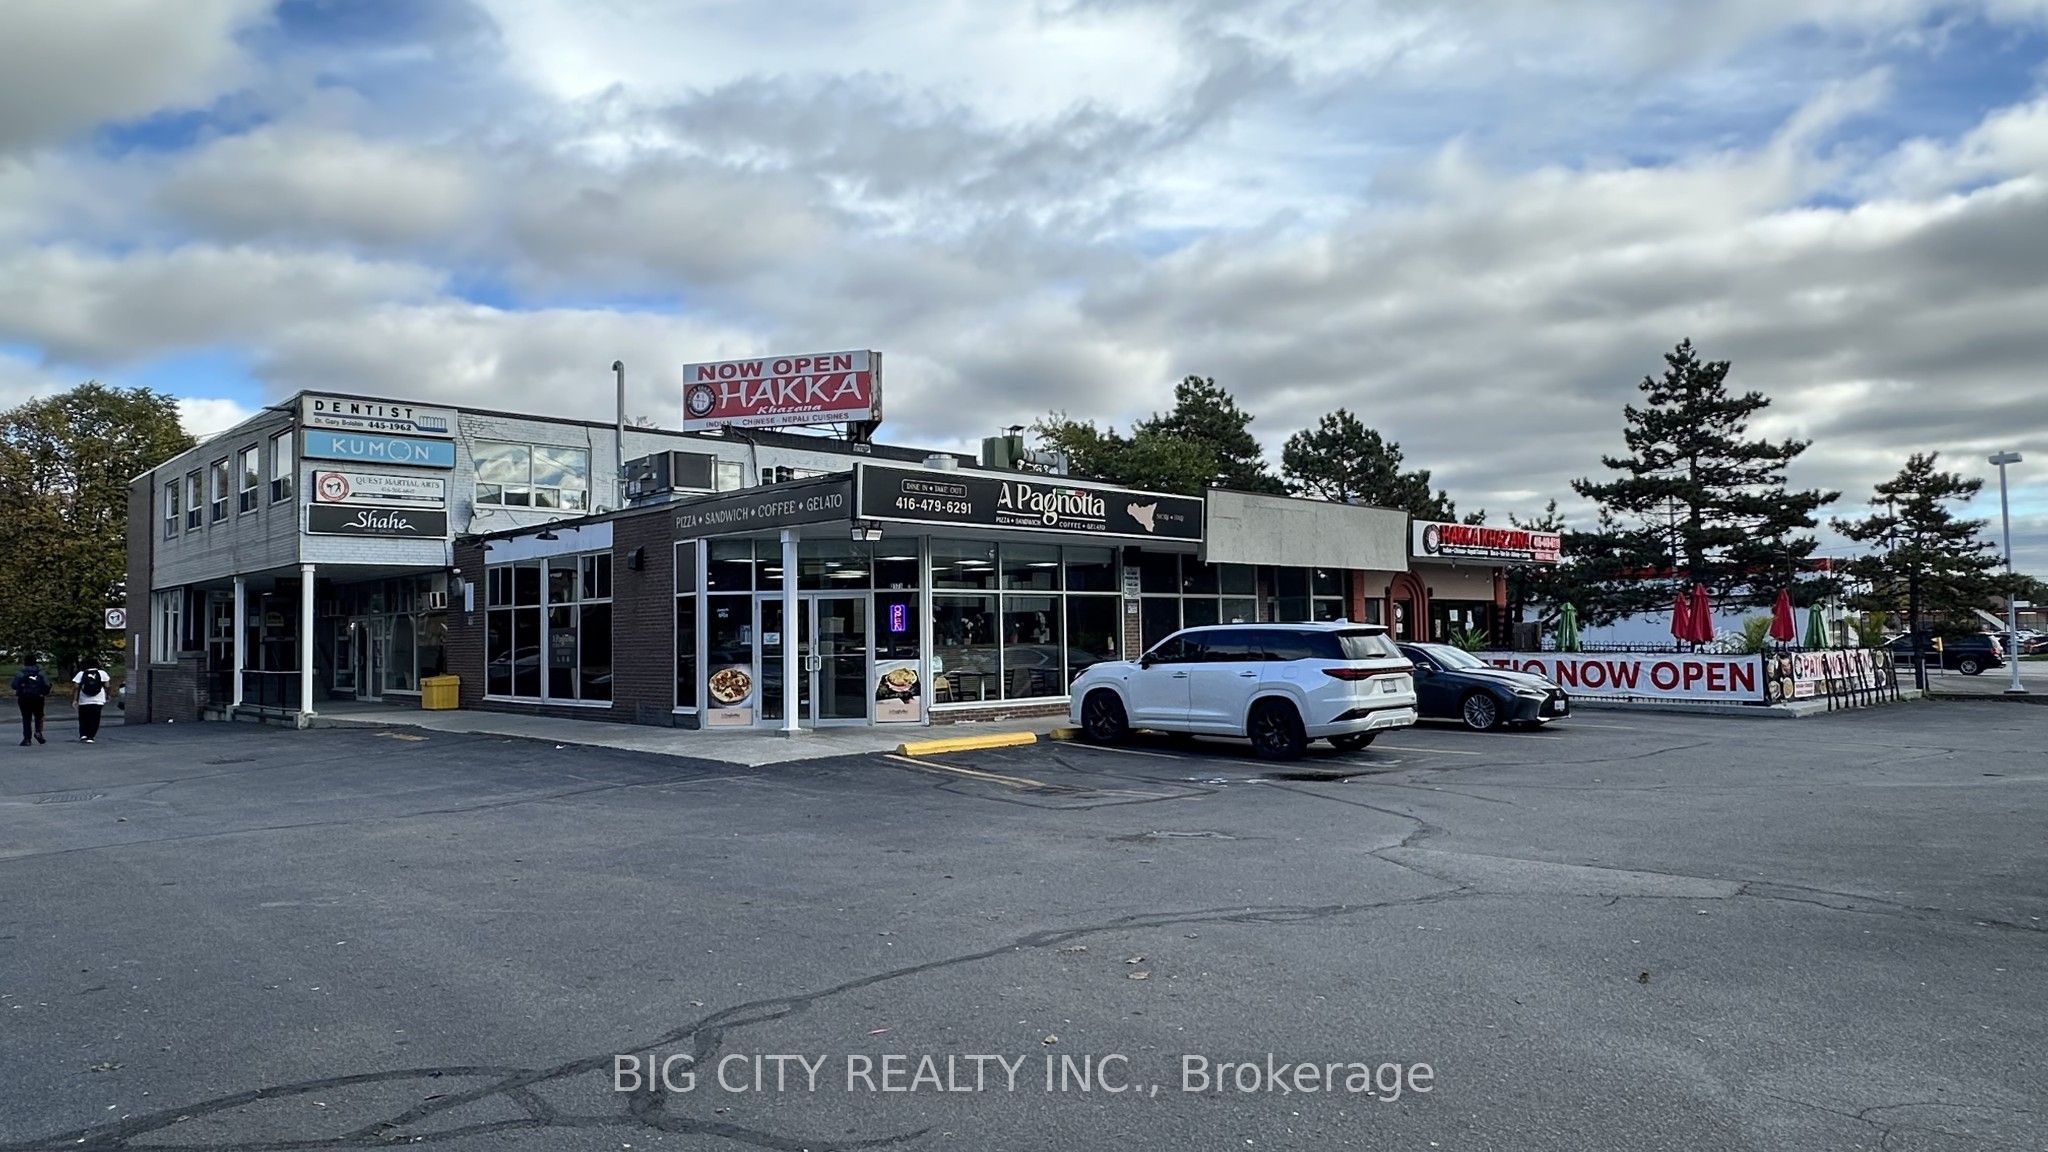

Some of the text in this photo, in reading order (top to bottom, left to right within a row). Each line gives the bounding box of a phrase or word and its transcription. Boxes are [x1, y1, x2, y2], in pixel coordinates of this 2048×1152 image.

[697, 354, 852, 381] NOW OPEN
[719, 373, 862, 409] HAKKA
[315, 400, 412, 419] DENTIST
[742, 417, 775, 426] CHINESE
[782, 415, 809, 424] NEPALI
[812, 412, 849, 422] CUISINES
[757, 404, 822, 415] Khazana
[368, 421, 412, 431] 445-1962
[332, 438, 430, 462] KUMON
[356, 476, 440, 489] QUEST MARTIAL ARTS
[675, 493, 843, 529] PIZZA SANDWICH COFFEE GELATO
[895, 496, 972, 515] 416-479-6291
[997, 482, 1105, 526] A Pagnotta
[341, 510, 417, 531] Shahe
[1059, 521, 1081, 529] COFFEE
[1556, 660, 1641, 689] NOW
[1651, 661, 1755, 692] OPEN
